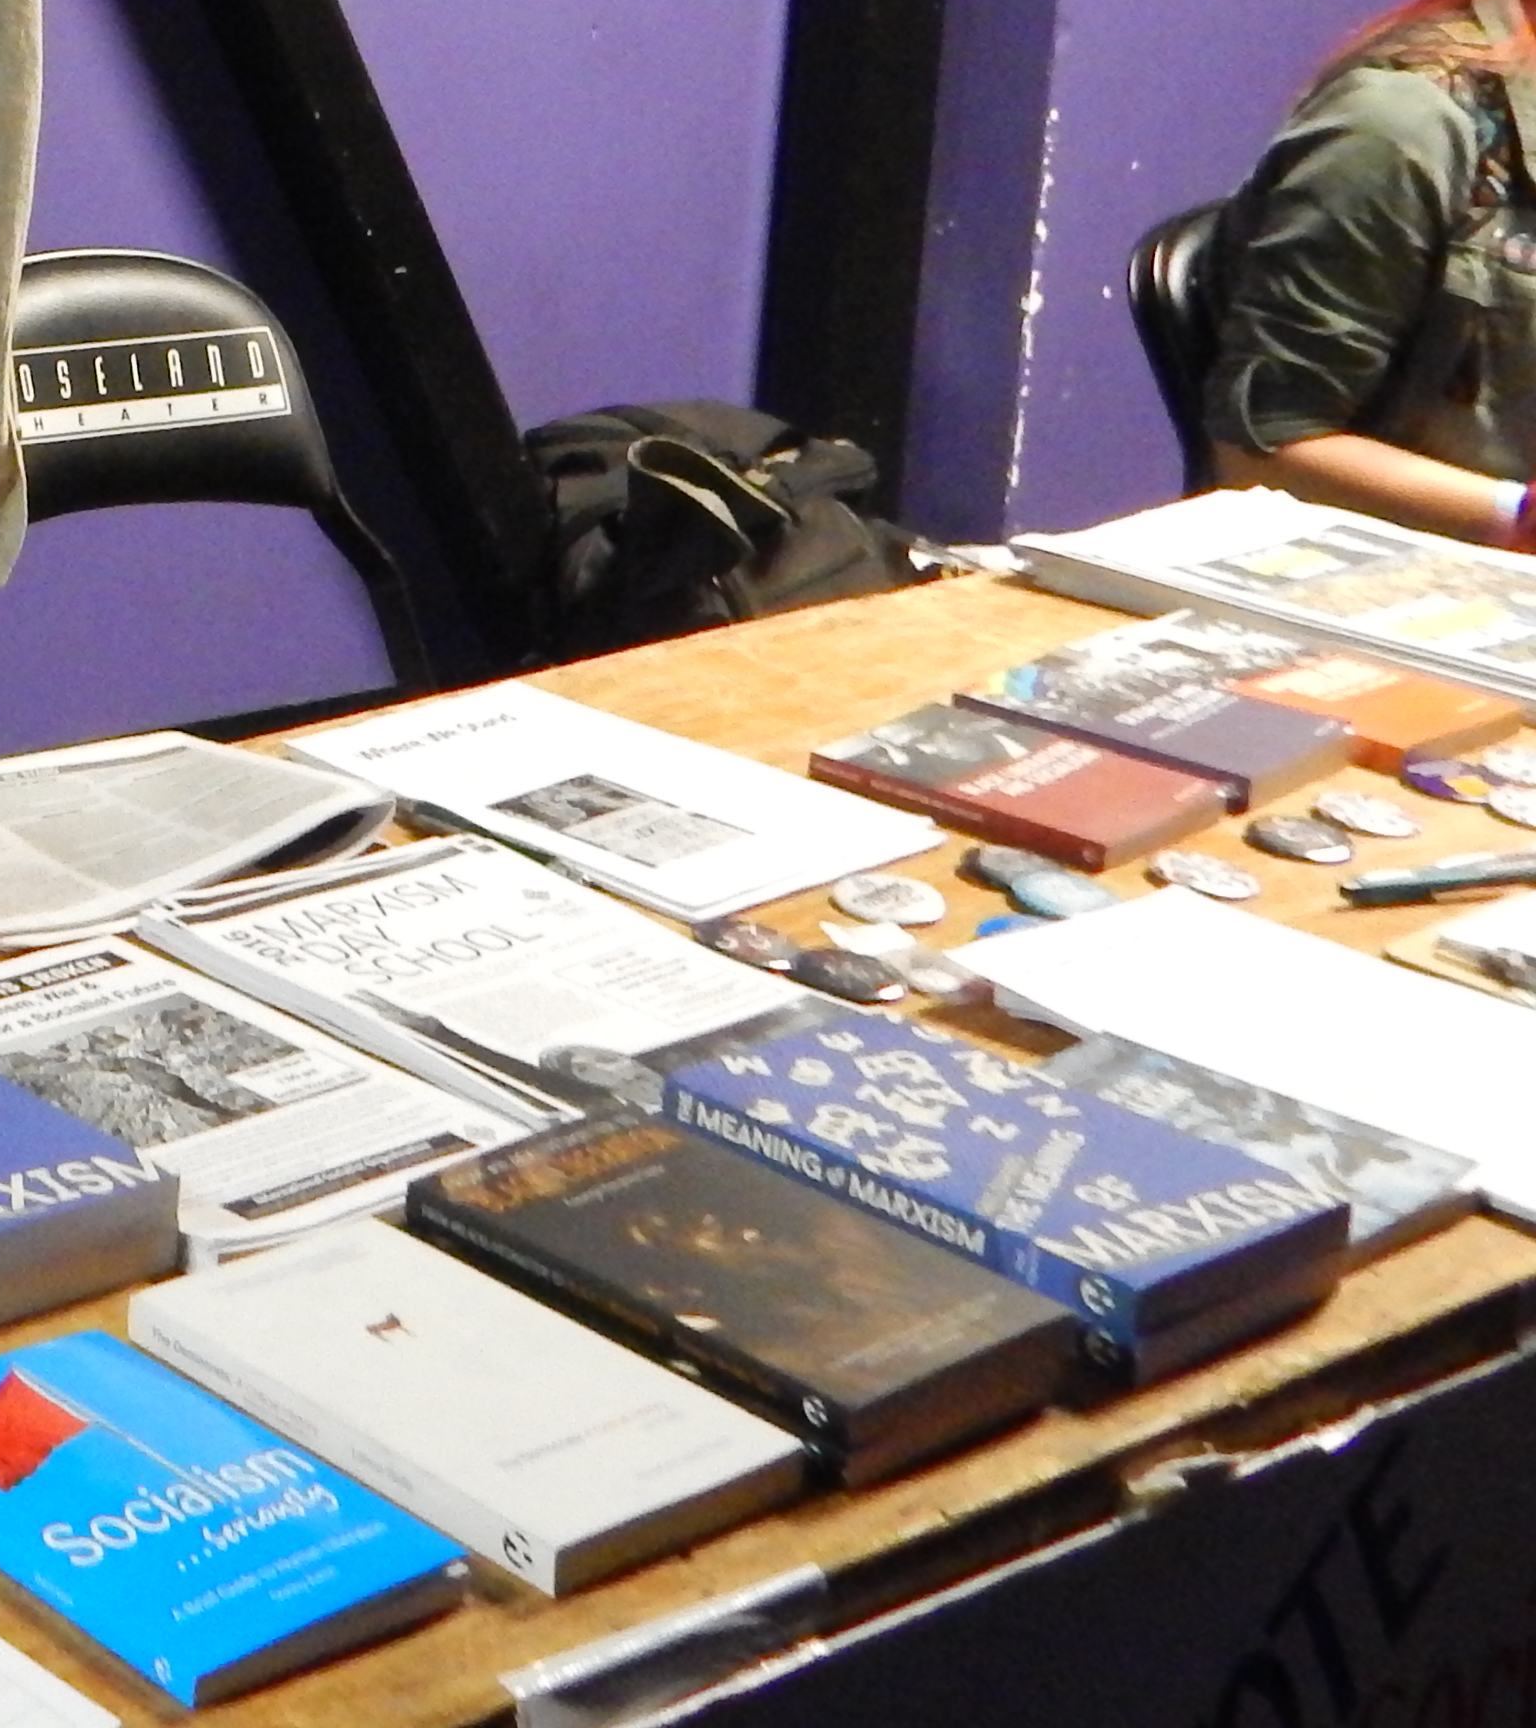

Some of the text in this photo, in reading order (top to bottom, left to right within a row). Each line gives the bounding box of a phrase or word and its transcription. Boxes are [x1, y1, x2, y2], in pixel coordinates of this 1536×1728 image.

[18, 340, 266, 404] OSELAND
[33, 391, 269, 432] HEATER
[356, 712, 518, 762] Where We Stand
[253, 871, 478, 945] MARXISM
[20, 952, 113, 988] BROKEN
[221, 928, 305, 967] 2016
[296, 923, 401, 966] DAY
[344, 922, 543, 985] SCHOOL
[696, 1100, 824, 1183] MEANING
[847, 1173, 987, 1258] MARXISM
[1032, 1178, 1350, 1272] MARXISM
[42, 1445, 317, 1568] Socialism
